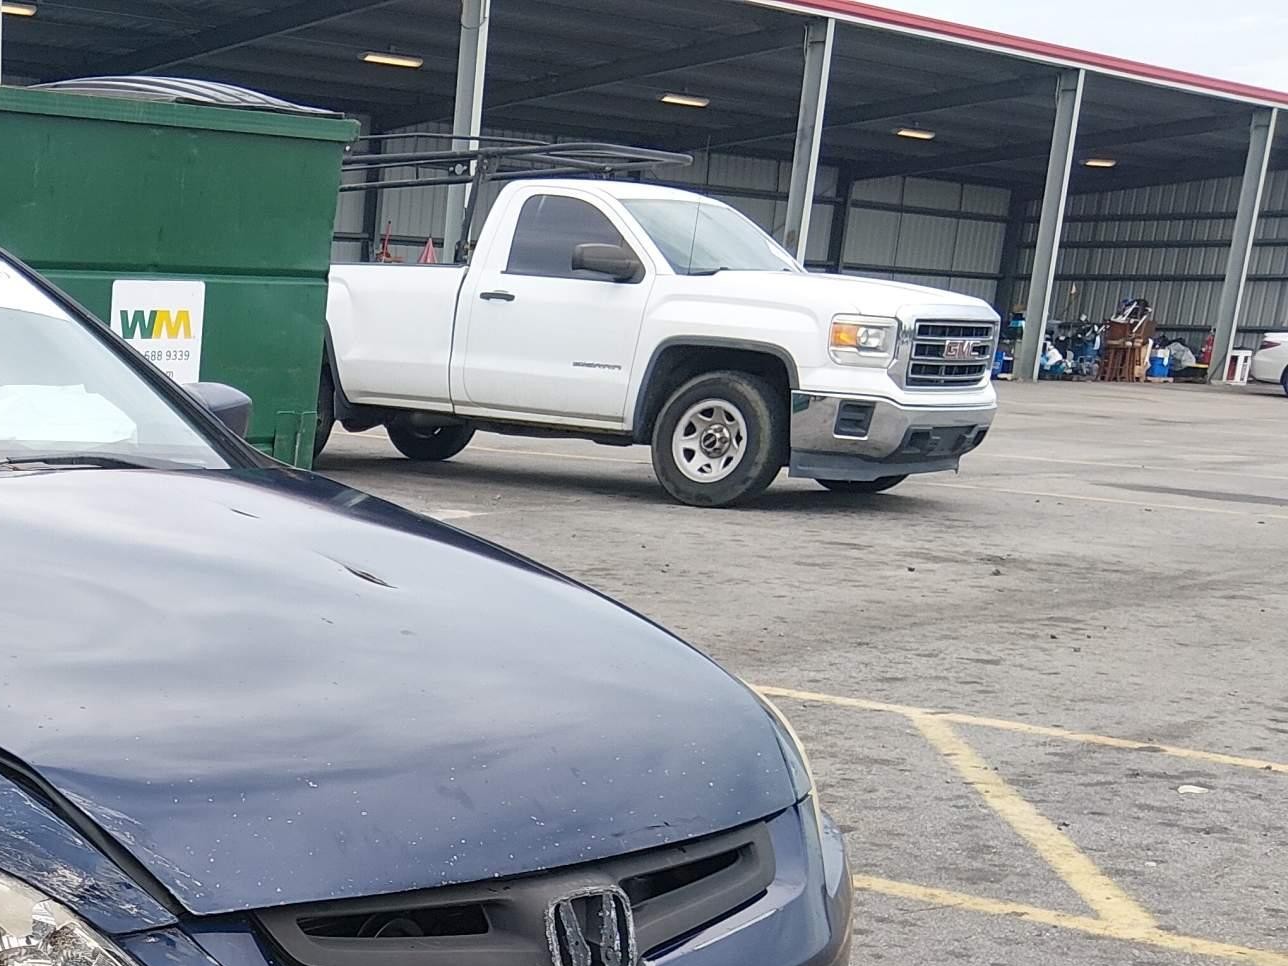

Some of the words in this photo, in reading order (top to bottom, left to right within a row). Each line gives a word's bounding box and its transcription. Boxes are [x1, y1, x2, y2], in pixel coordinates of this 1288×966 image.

[120, 310, 191, 339] WM
[165, 350, 190, 360] 9339
[943, 340, 981, 359] GMC
